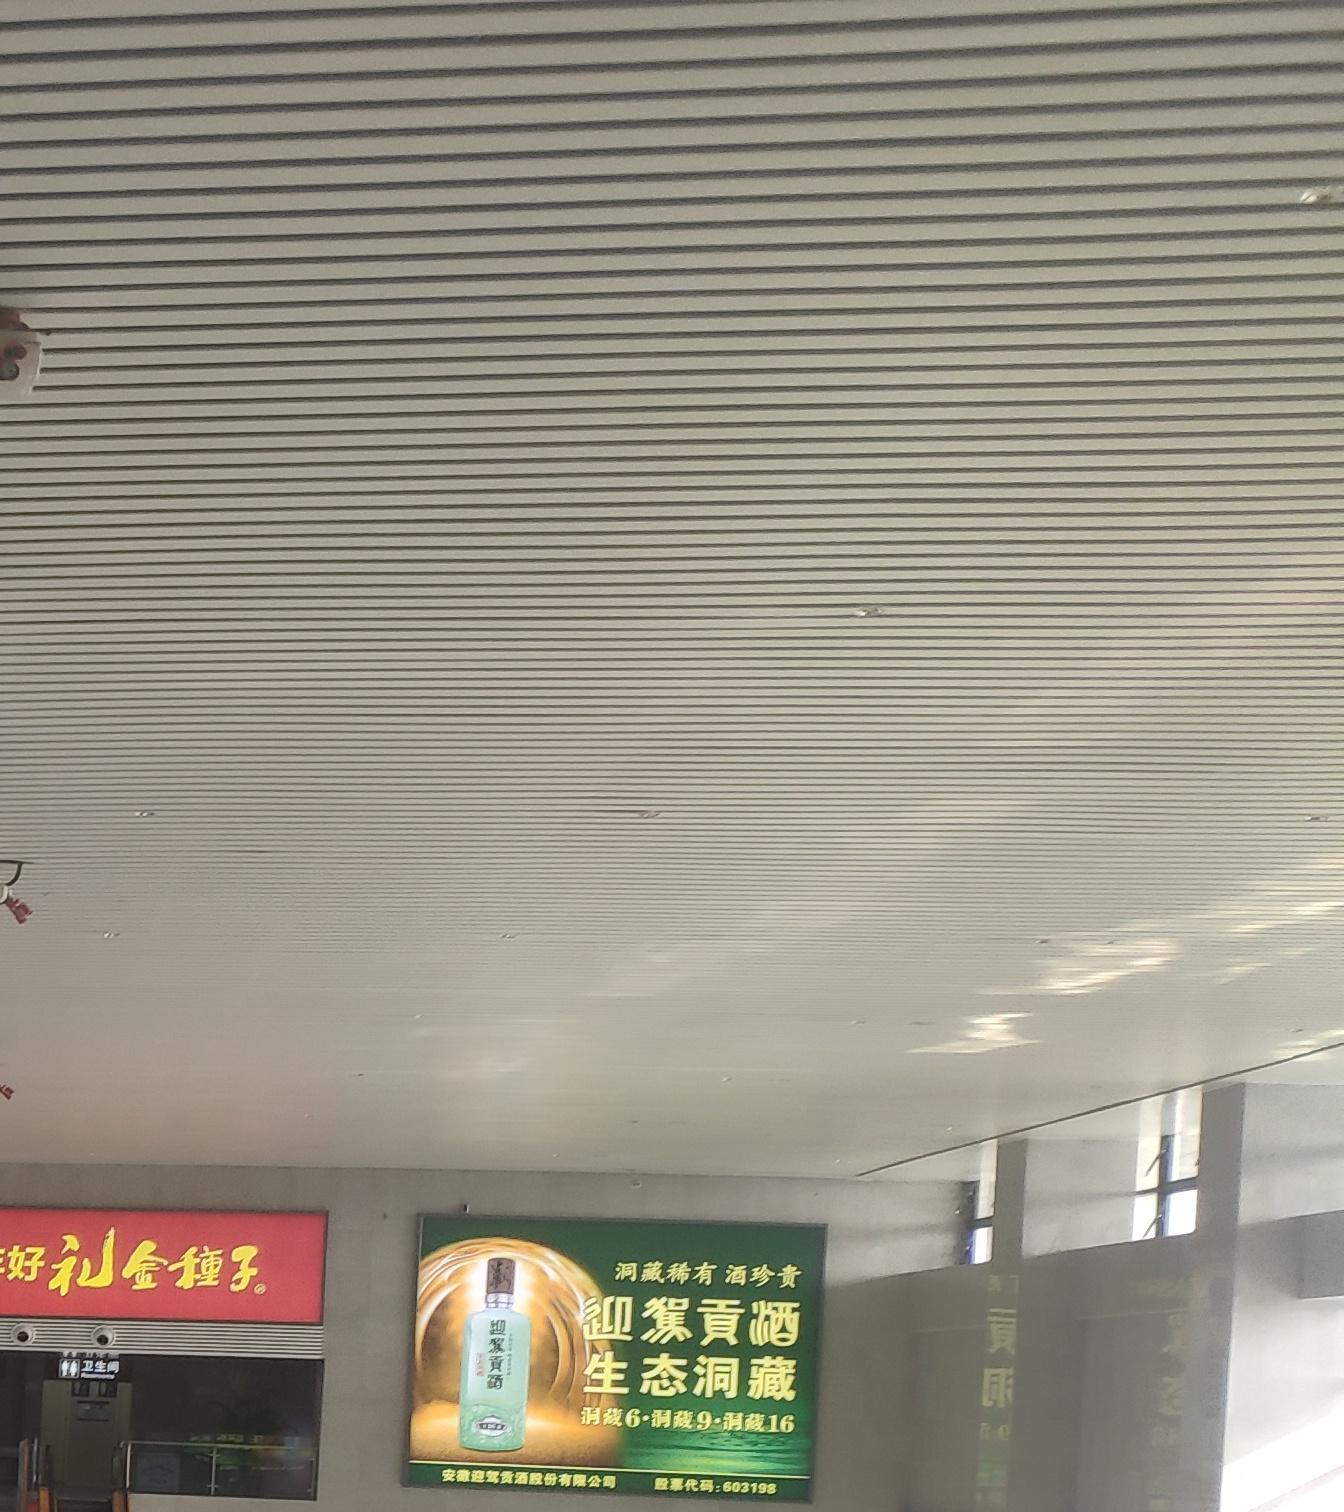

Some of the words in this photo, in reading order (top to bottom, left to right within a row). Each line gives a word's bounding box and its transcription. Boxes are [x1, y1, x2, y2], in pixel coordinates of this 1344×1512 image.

[614, 1261, 718, 1287] 洞藏稀有
[724, 1263, 803, 1289] 酒珍贵
[81, 1359, 120, 1374] 卫生间
[583, 1351, 798, 1402] 生态洞藏
